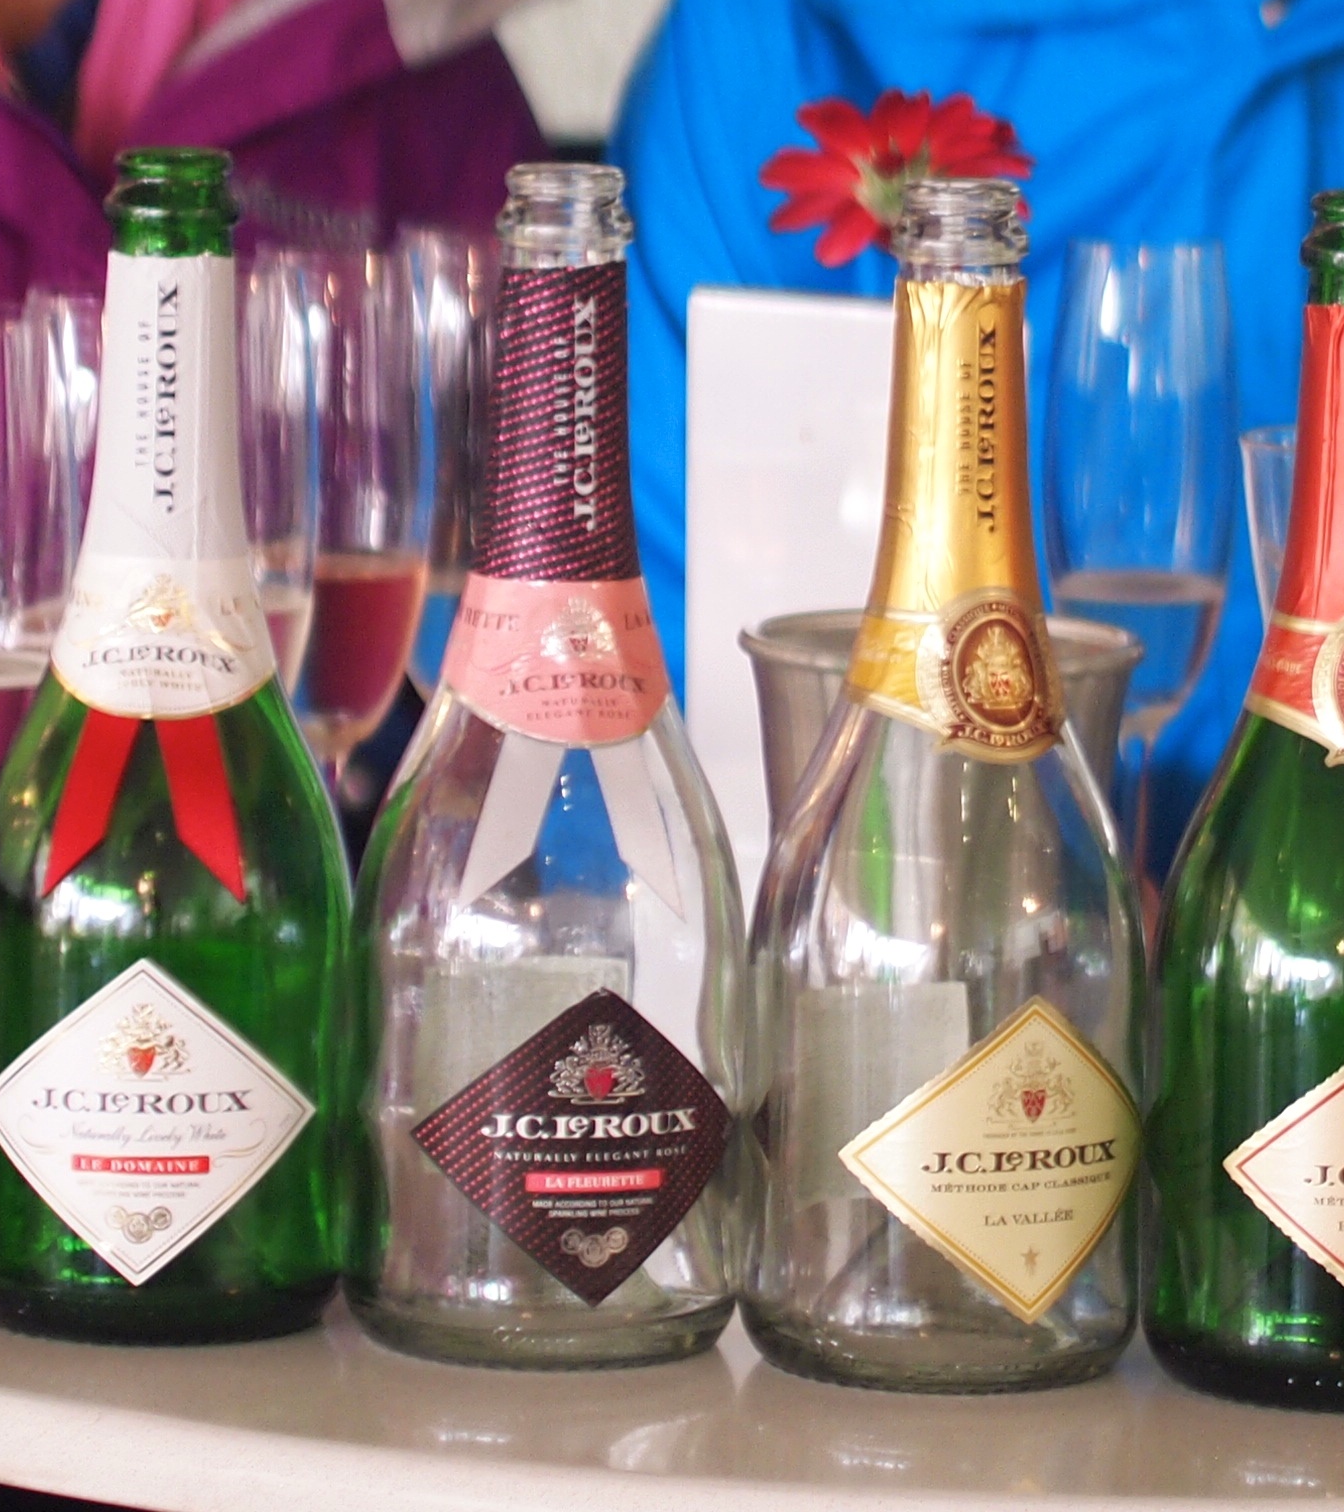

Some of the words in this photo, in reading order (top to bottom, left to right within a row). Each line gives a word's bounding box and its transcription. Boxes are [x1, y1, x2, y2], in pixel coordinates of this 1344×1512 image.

[492, 1149, 578, 1163] NATURALLY
[585, 1149, 649, 1163] ELEGANT
[79, 1157, 102, 1172] LE
[109, 1158, 201, 1174] DOMAINE
[544, 1176, 563, 1189] LA
[1011, 1181, 1040, 1192] CAP
[1043, 1172, 1111, 1189] CLASSIQUE
[984, 1214, 1008, 1227] LA
[1012, 1208, 1074, 1225] VALLÉE
